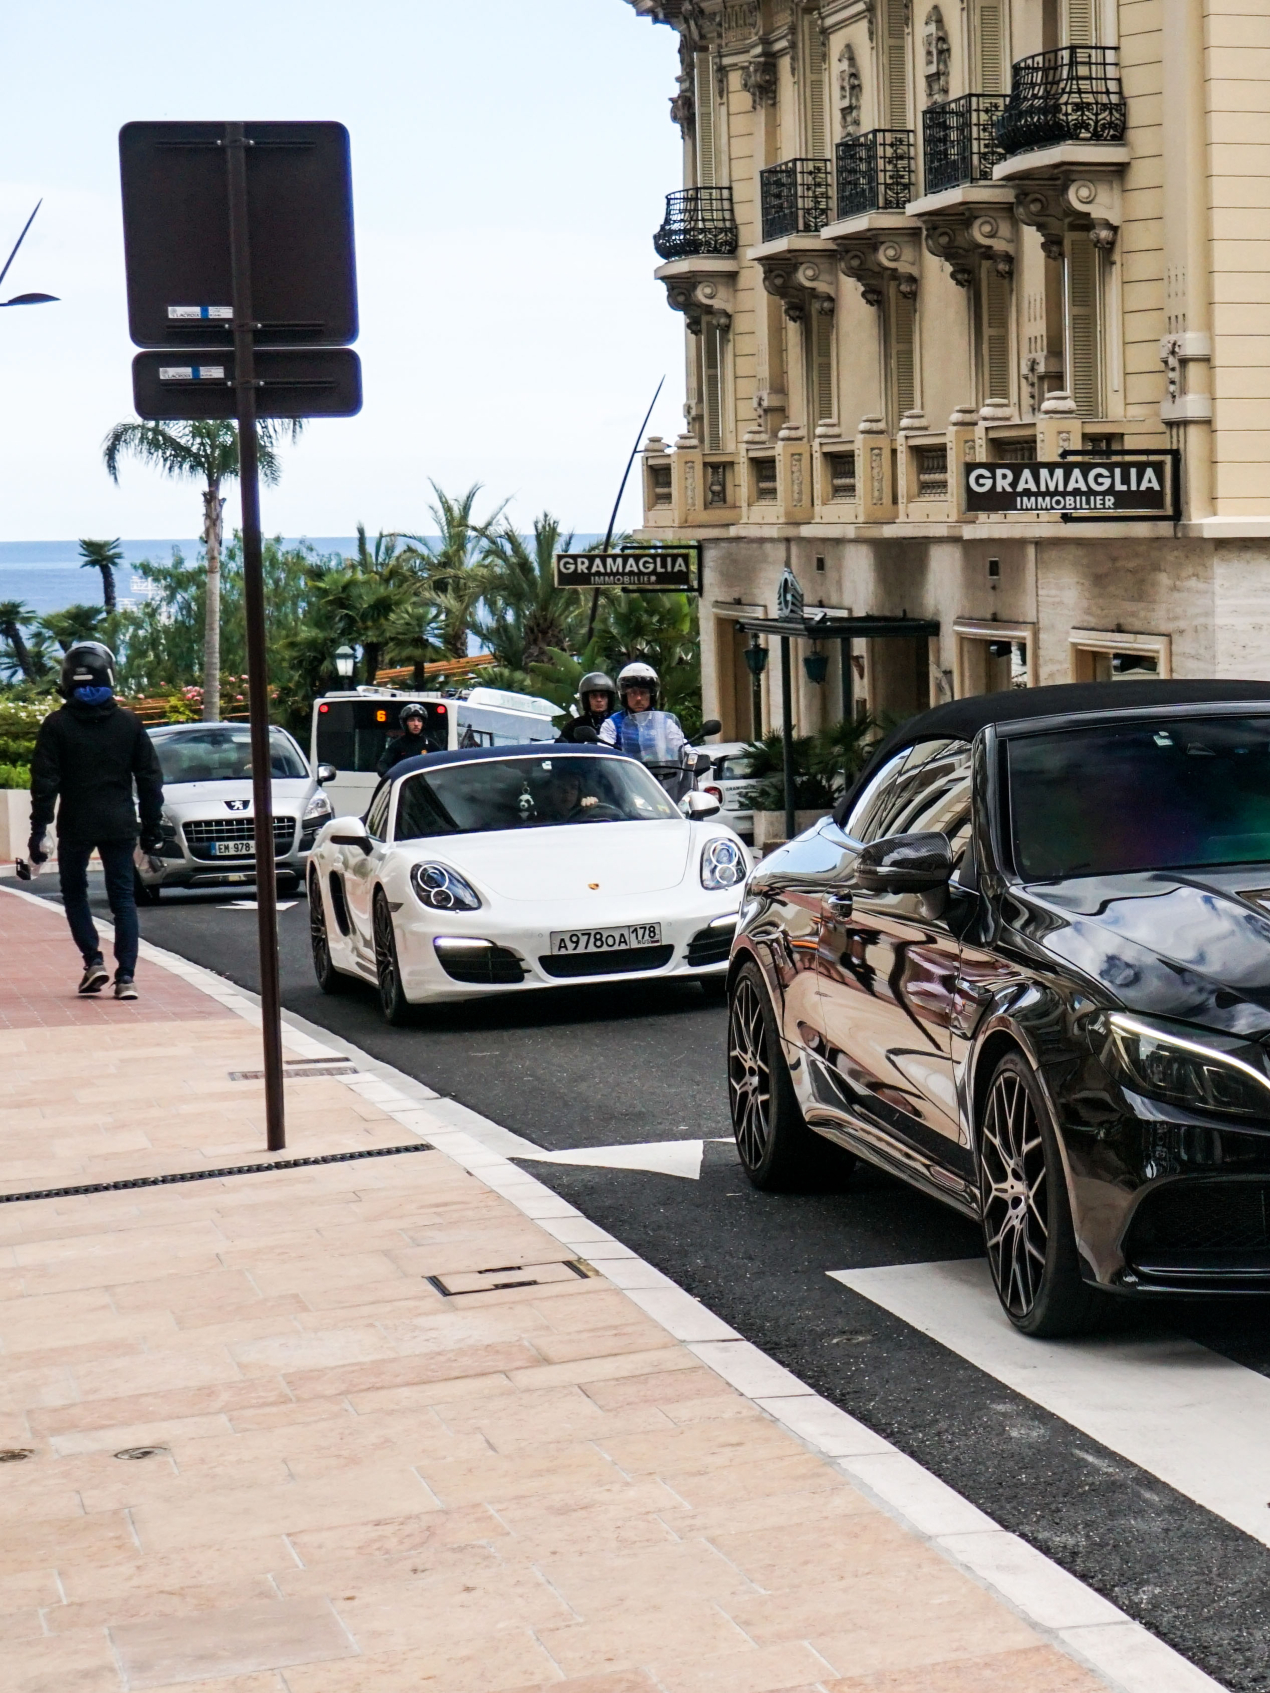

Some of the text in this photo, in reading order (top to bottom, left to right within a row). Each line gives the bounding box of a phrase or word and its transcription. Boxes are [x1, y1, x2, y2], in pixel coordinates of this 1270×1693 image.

[968, 467, 1161, 492] GRAMAGLIA
[1016, 495, 1115, 510] IMMOBILIER
[559, 557, 687, 574] GRAMAGLIA
[590, 575, 657, 585] IMMOBILIER
[376, 710, 387, 722] 6
[631, 925, 657, 941] 178
